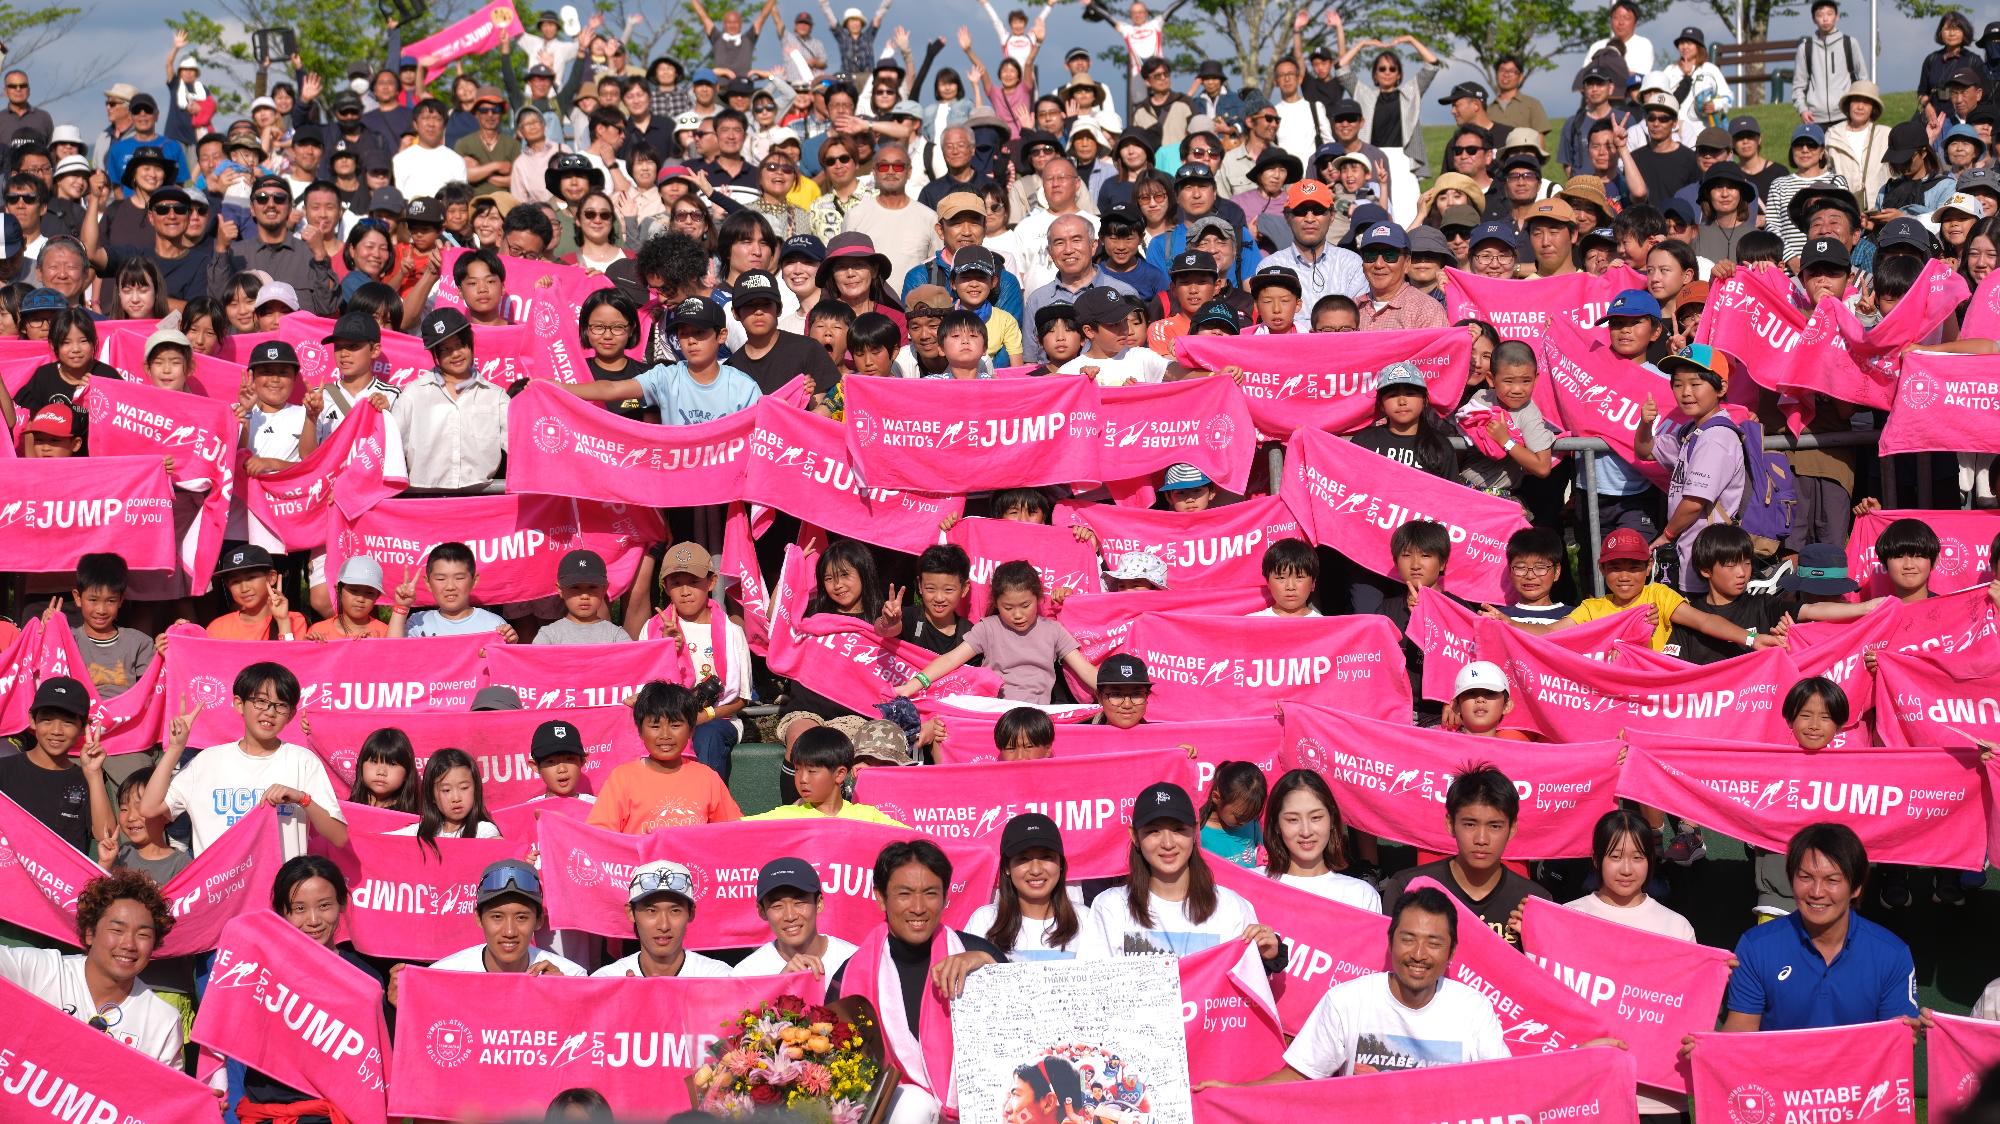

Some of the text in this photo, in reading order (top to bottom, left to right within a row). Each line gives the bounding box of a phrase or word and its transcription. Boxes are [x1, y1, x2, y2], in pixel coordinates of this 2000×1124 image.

[1490, 311, 1546, 323] WATABE
[504, 357, 515, 382] LAST
[1560, 354, 1594, 387] WATABE
[1308, 374, 1318, 399] LAST
[1945, 381, 2000, 394] WATAB
[1599, 388, 1618, 418] LAST
[112, 415, 162, 442] AKITO's
[116, 401, 174, 432] WATABE
[881, 418, 941, 434] WATABE
[1069, 410, 1096, 422] powe
[1150, 419, 1200, 433] AKITO's
[193, 427, 209, 456] LAST
[882, 433, 934, 448] AKITO's
[967, 420, 979, 448] LAST
[981, 412, 1066, 448] JUMP
[1069, 424, 1084, 438] by
[1103, 420, 1116, 448] LAST
[1142, 433, 1200, 446] WATABE
[650, 448, 662, 471] LAST
[663, 437, 745, 470] JUMP
[802, 449, 814, 479] LAST
[24, 500, 36, 529] LAST
[36, 499, 123, 529] JUMP
[902, 497, 939, 514] by you
[1366, 496, 1382, 525] LAST
[124, 511, 162, 526] by you
[364, 534, 420, 551] WATABE
[1165, 541, 1177, 567] LAST
[1178, 529, 1262, 567] JUMP
[1465, 544, 1503, 564] by you
[1147, 650, 1206, 671] WATABE
[1336, 650, 1381, 665] powered
[429, 677, 476, 691] powered
[1147, 665, 1198, 686] AKITO's
[1233, 658, 1245, 688] LAST
[1246, 655, 1332, 688] JUMP
[1337, 667, 1371, 681] by you
[321, 683, 333, 710] LAST
[334, 681, 425, 710] JUMP
[1538, 689, 1591, 711] AKITO's
[1641, 689, 1735, 719] JUMP
[1736, 700, 1772, 712] by you
[1333, 751, 1395, 777] WATABE
[1333, 767, 1387, 792] AKITO's
[1422, 770, 1435, 801] LAST
[1537, 780, 1592, 795] powered
[1536, 795, 1576, 812] by you
[1788, 780, 1801, 810] LAST
[1801, 781, 1903, 816] JUMP
[1909, 788, 1965, 801] powered
[913, 807, 977, 822] WATABE
[1907, 806, 1949, 819] by you
[205, 854, 253, 888] powered
[207, 878, 246, 905] by you
[352, 879, 429, 914] JUMP
[430, 884, 440, 914] LAST
[250, 967, 274, 1005] LAST
[1043, 974, 1088, 984] THANK YOU
[1457, 963, 1524, 1021] WATABE
[1622, 984, 1684, 1009] powered
[263, 982, 365, 1062] JUMP
[1204, 1015, 1247, 1032] by you
[1617, 1000, 1665, 1024] by you
[427, 1019, 474, 1044] SYMBOL ATHLETES
[481, 1029, 558, 1047] WATABE
[448, 1048, 472, 1068] ACTION
[479, 1049, 548, 1067] AKITO's
[592, 1032, 605, 1068] LAST
[1357, 1053, 1415, 1069] WATABE
[357, 1062, 372, 1081] by
[2, 1060, 119, 1124] JUMP
[1783, 1085, 1861, 1107] WATABE
[1896, 1078, 1909, 1114] LAST
[1539, 1099, 1600, 1124] powered
